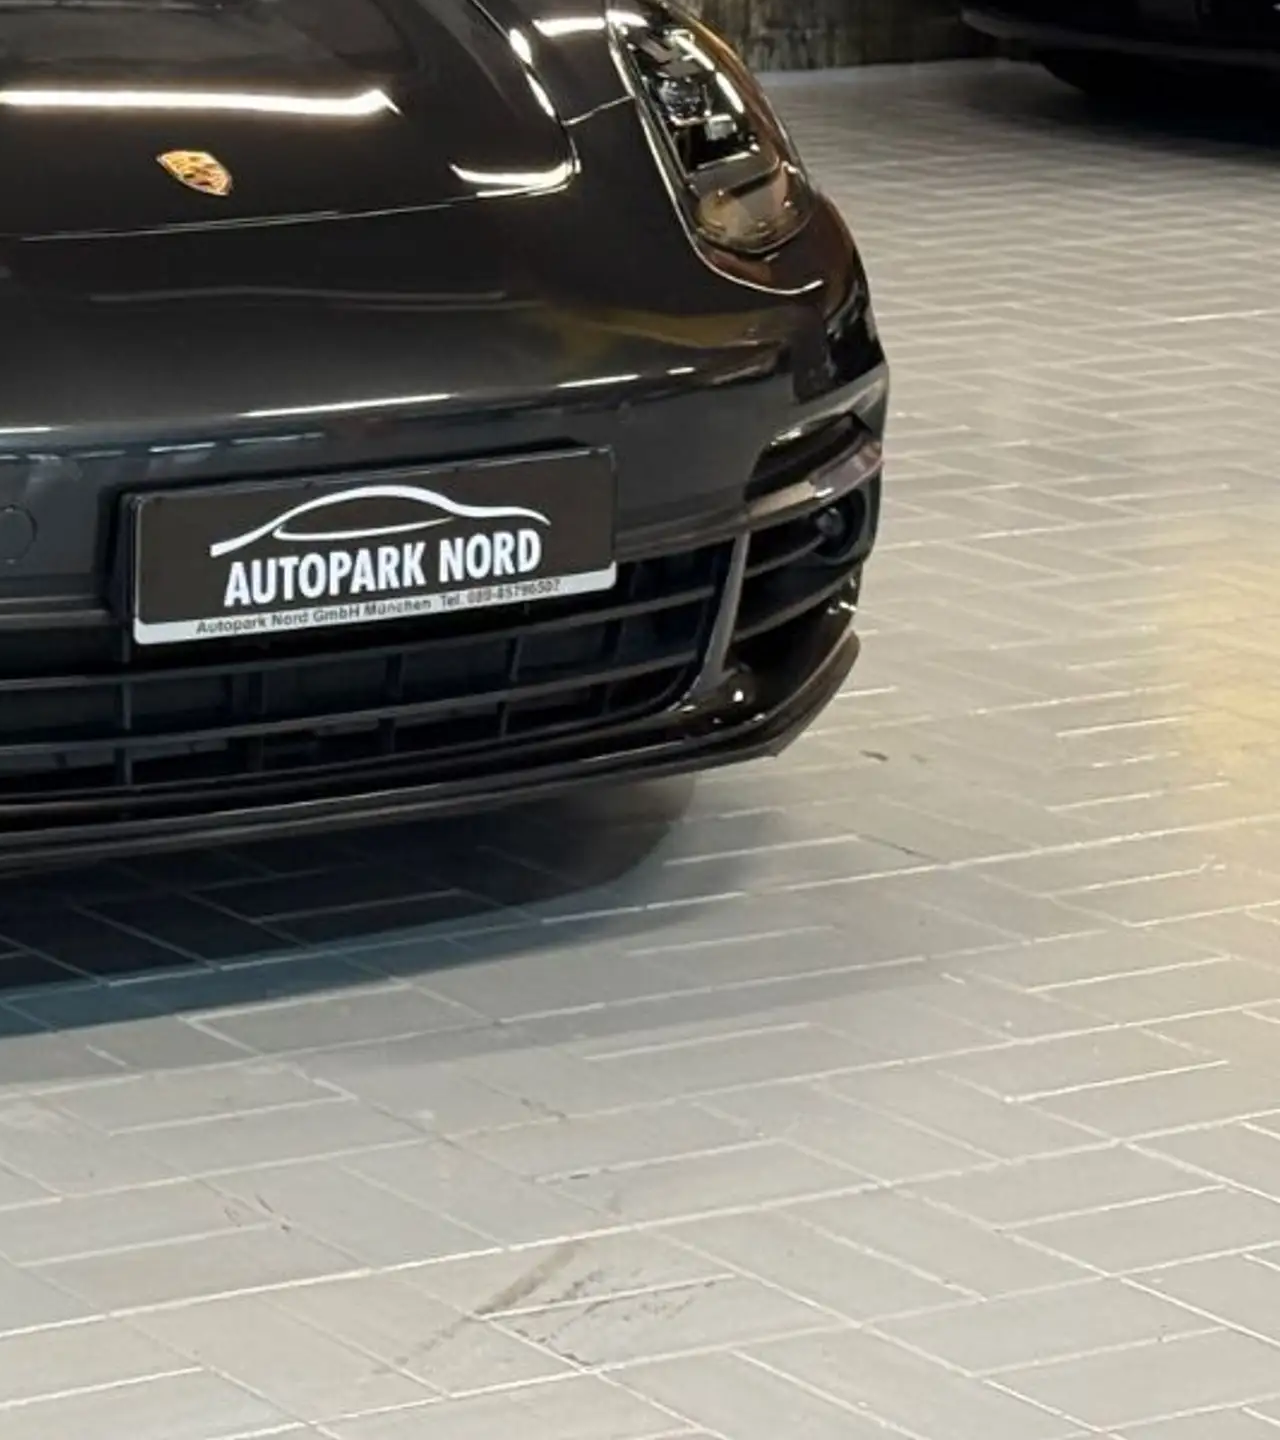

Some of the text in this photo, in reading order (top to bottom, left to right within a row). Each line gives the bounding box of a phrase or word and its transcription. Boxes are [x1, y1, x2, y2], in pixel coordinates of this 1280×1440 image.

[224, 529, 541, 608] AUTOPARK NORD
[195, 613, 267, 636] Autopark
[271, 611, 308, 627] Nord
[313, 604, 360, 623] GmbH
